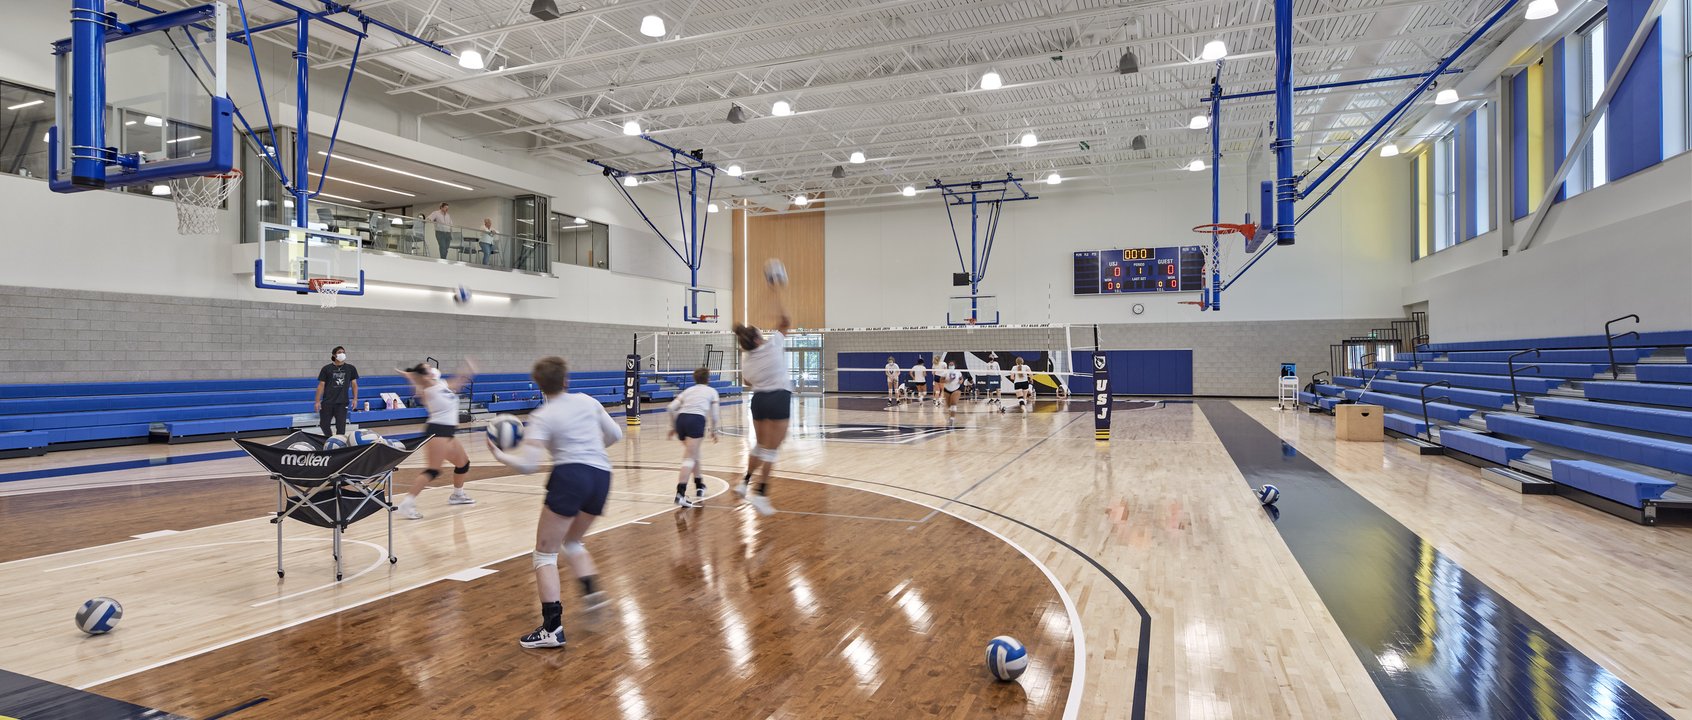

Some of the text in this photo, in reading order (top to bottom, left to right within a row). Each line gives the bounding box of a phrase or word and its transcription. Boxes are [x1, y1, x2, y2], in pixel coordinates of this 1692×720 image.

[1114, 266, 1120, 276] 0
[1168, 264, 1174, 274] 0
[1096, 379, 1108, 419] USJ
[281, 453, 331, 466] molten
